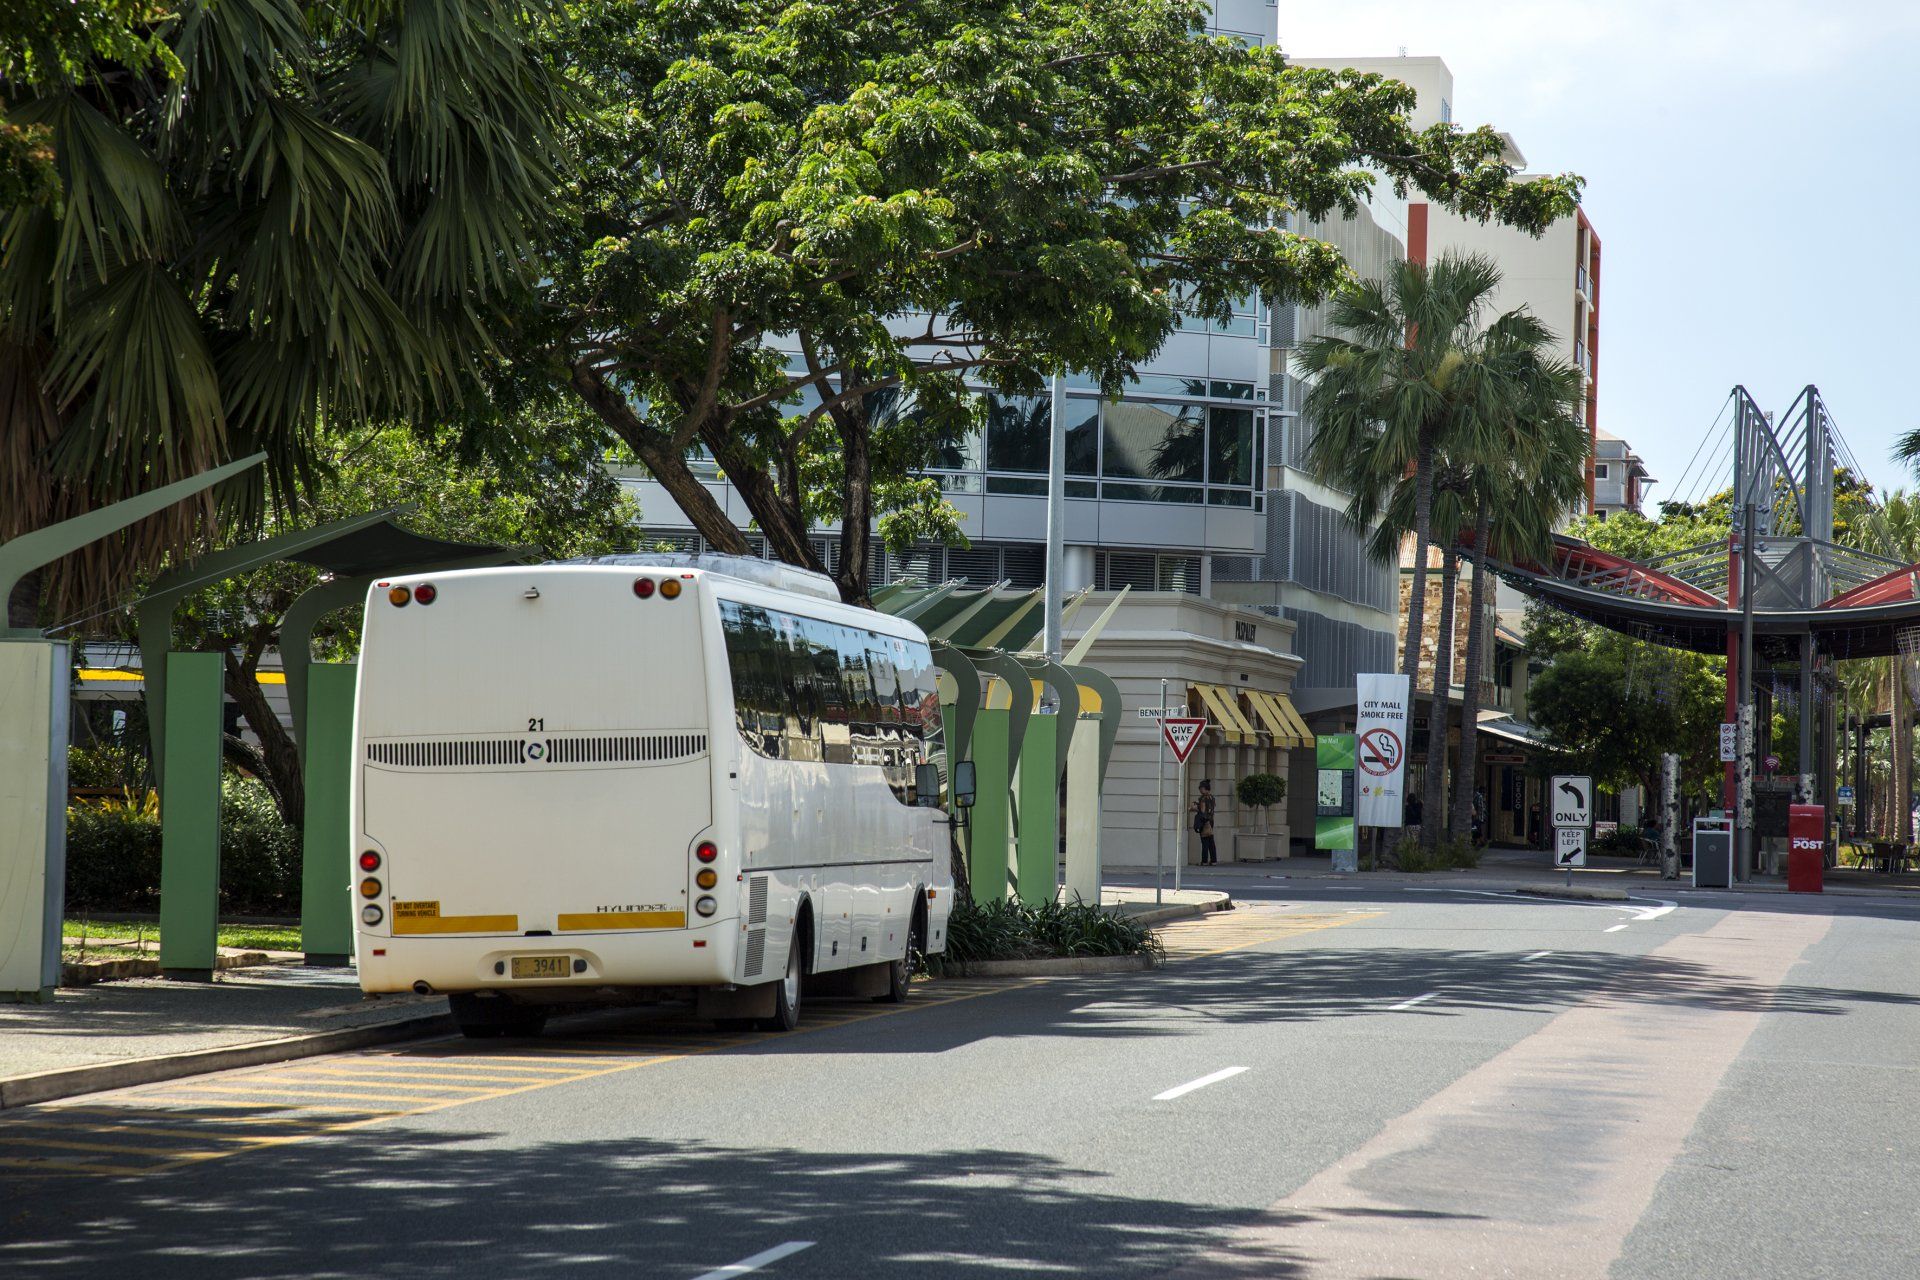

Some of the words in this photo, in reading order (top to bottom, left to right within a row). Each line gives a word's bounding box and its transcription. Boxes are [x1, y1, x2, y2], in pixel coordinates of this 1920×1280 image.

[1363, 700, 1379, 708] CITY
[1380, 701, 1401, 709] MALL
[1360, 711, 1385, 719] SMOKE
[1387, 712, 1404, 720] FREE
[528, 717, 544, 731] 21
[1171, 726, 1193, 734] GIVE
[1555, 812, 1587, 822] ONLY
[1793, 840, 1824, 850] POST
[395, 902, 402, 910] DO
[403, 902, 413, 910] NOT
[413, 902, 437, 910] OVERTAKE
[534, 958, 562, 973] 3941
